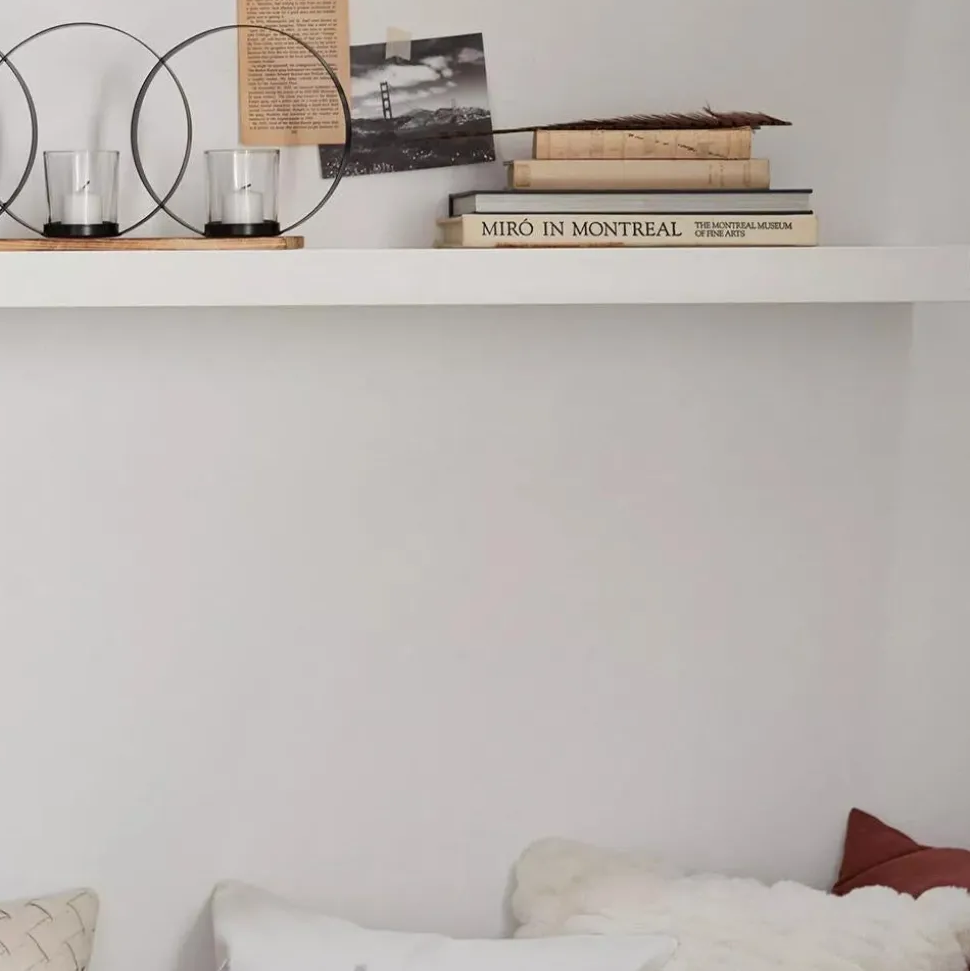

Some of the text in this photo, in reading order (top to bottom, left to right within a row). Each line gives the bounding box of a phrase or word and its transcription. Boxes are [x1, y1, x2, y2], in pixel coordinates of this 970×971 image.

[481, 218, 683, 237] MIRÓ IN MONTREAL
[694, 221, 793, 230] THE MONTREAL MUSEUM
[694, 230, 746, 238] OF FINE ARTS
